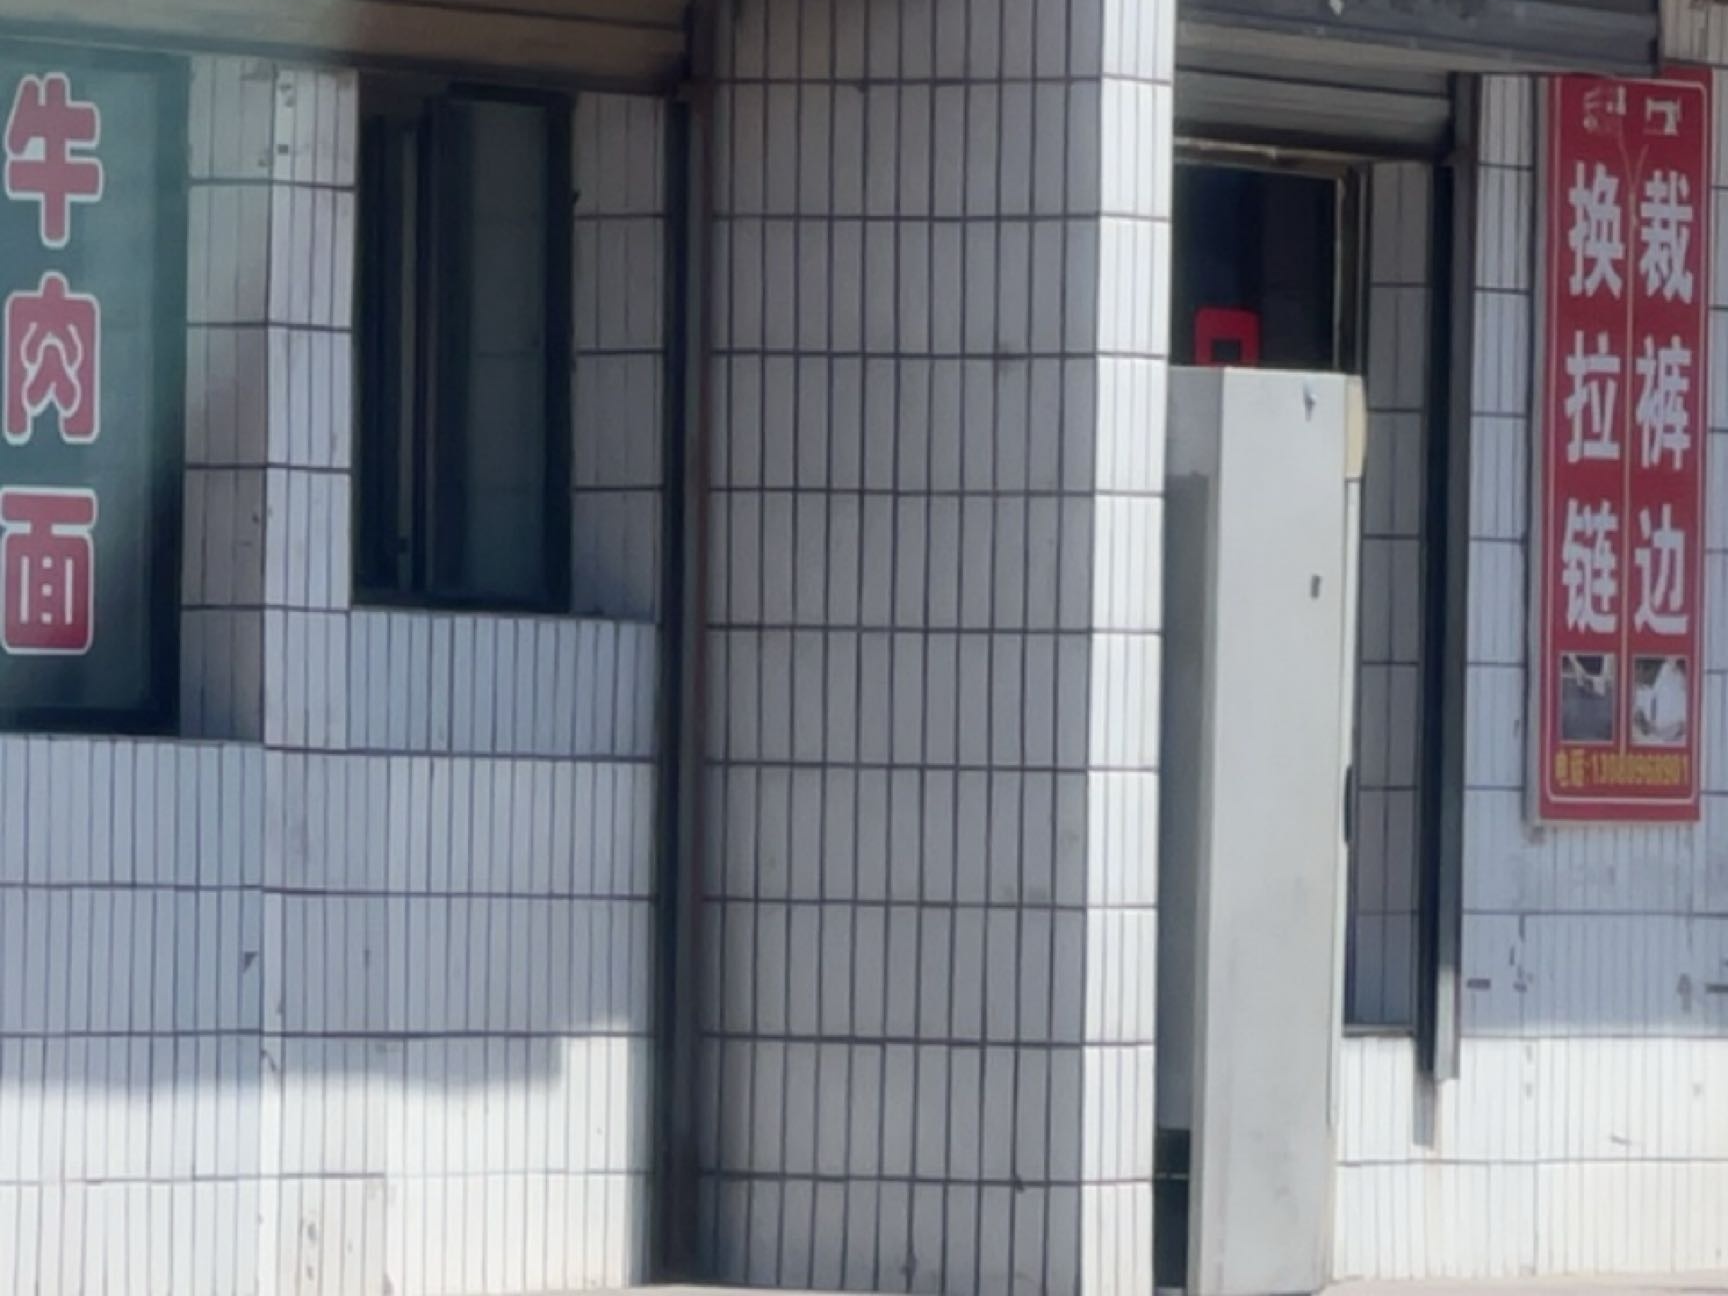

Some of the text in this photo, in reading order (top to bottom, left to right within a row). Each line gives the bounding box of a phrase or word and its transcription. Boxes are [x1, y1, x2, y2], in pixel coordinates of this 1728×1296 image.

[0, 72, 102, 655] 牛肉面
[1561, 161, 1624, 636] 换拉链
[1633, 170, 1694, 636] 裁裤边
